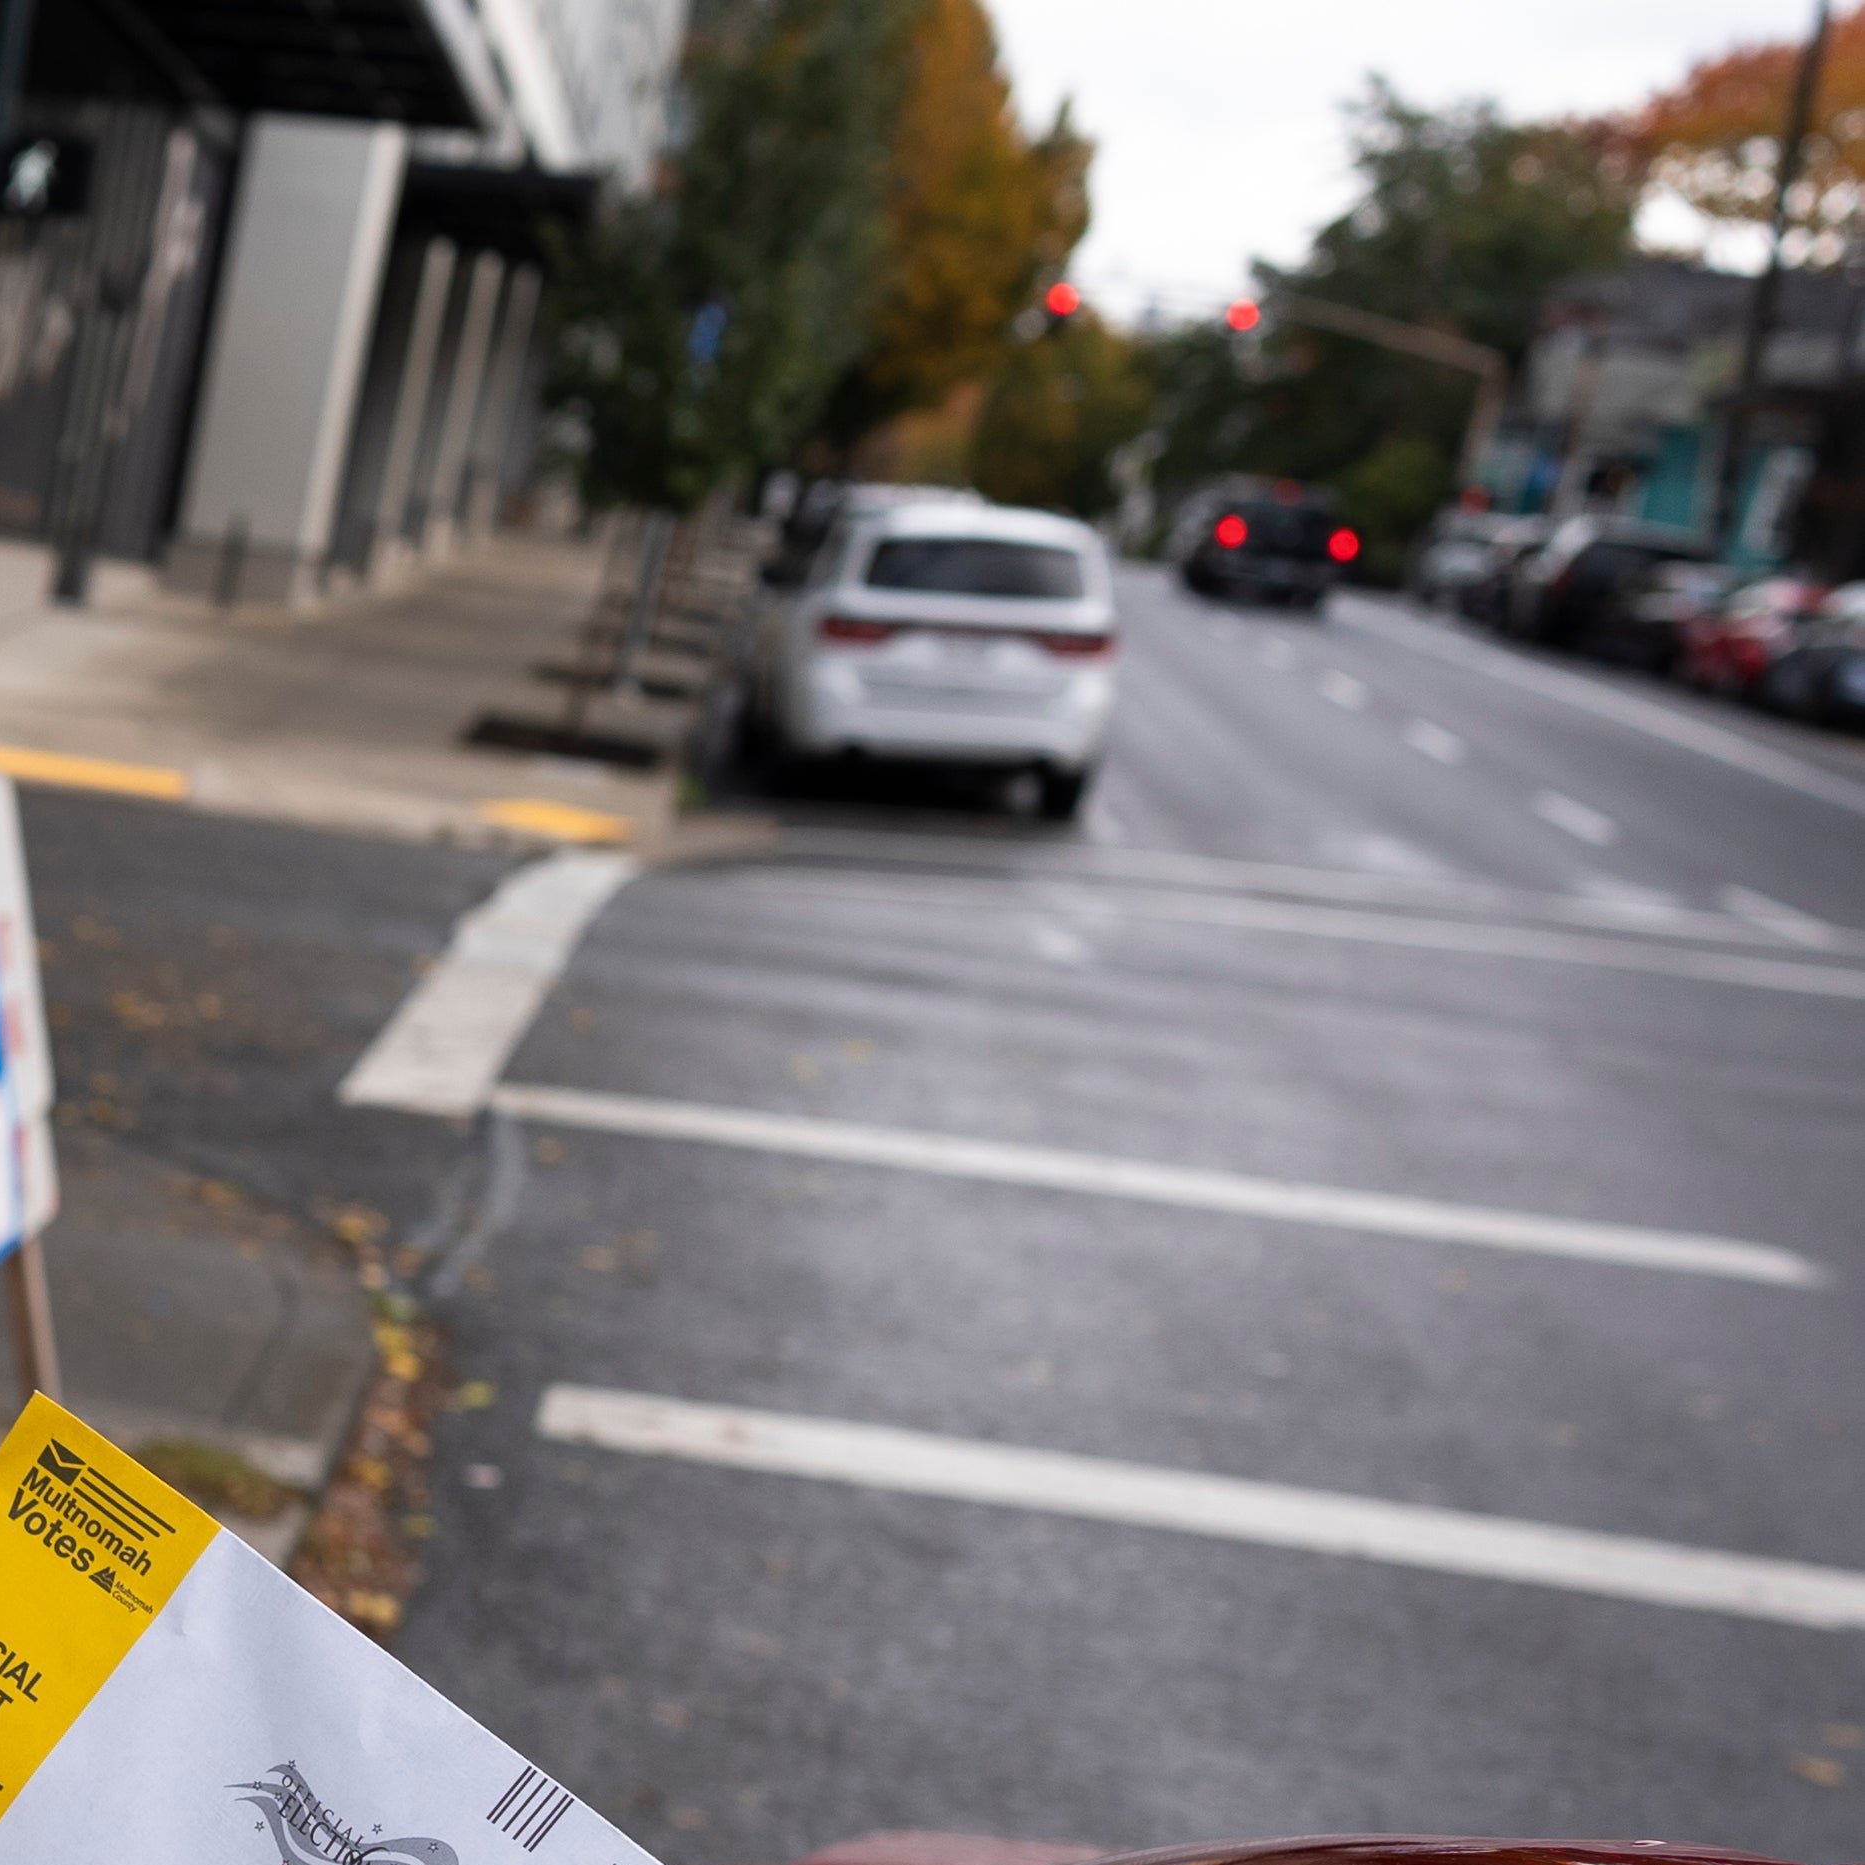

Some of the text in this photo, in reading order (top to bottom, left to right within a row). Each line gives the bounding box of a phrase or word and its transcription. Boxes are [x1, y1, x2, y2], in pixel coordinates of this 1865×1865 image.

[8, 1487, 95, 1572] Votes
[21, 1466, 152, 1577] Multnomah
[112, 1591, 137, 1613] County
[114, 1581, 153, 1614] Multnomah
[281, 1774, 365, 1849] OFFICIAL
